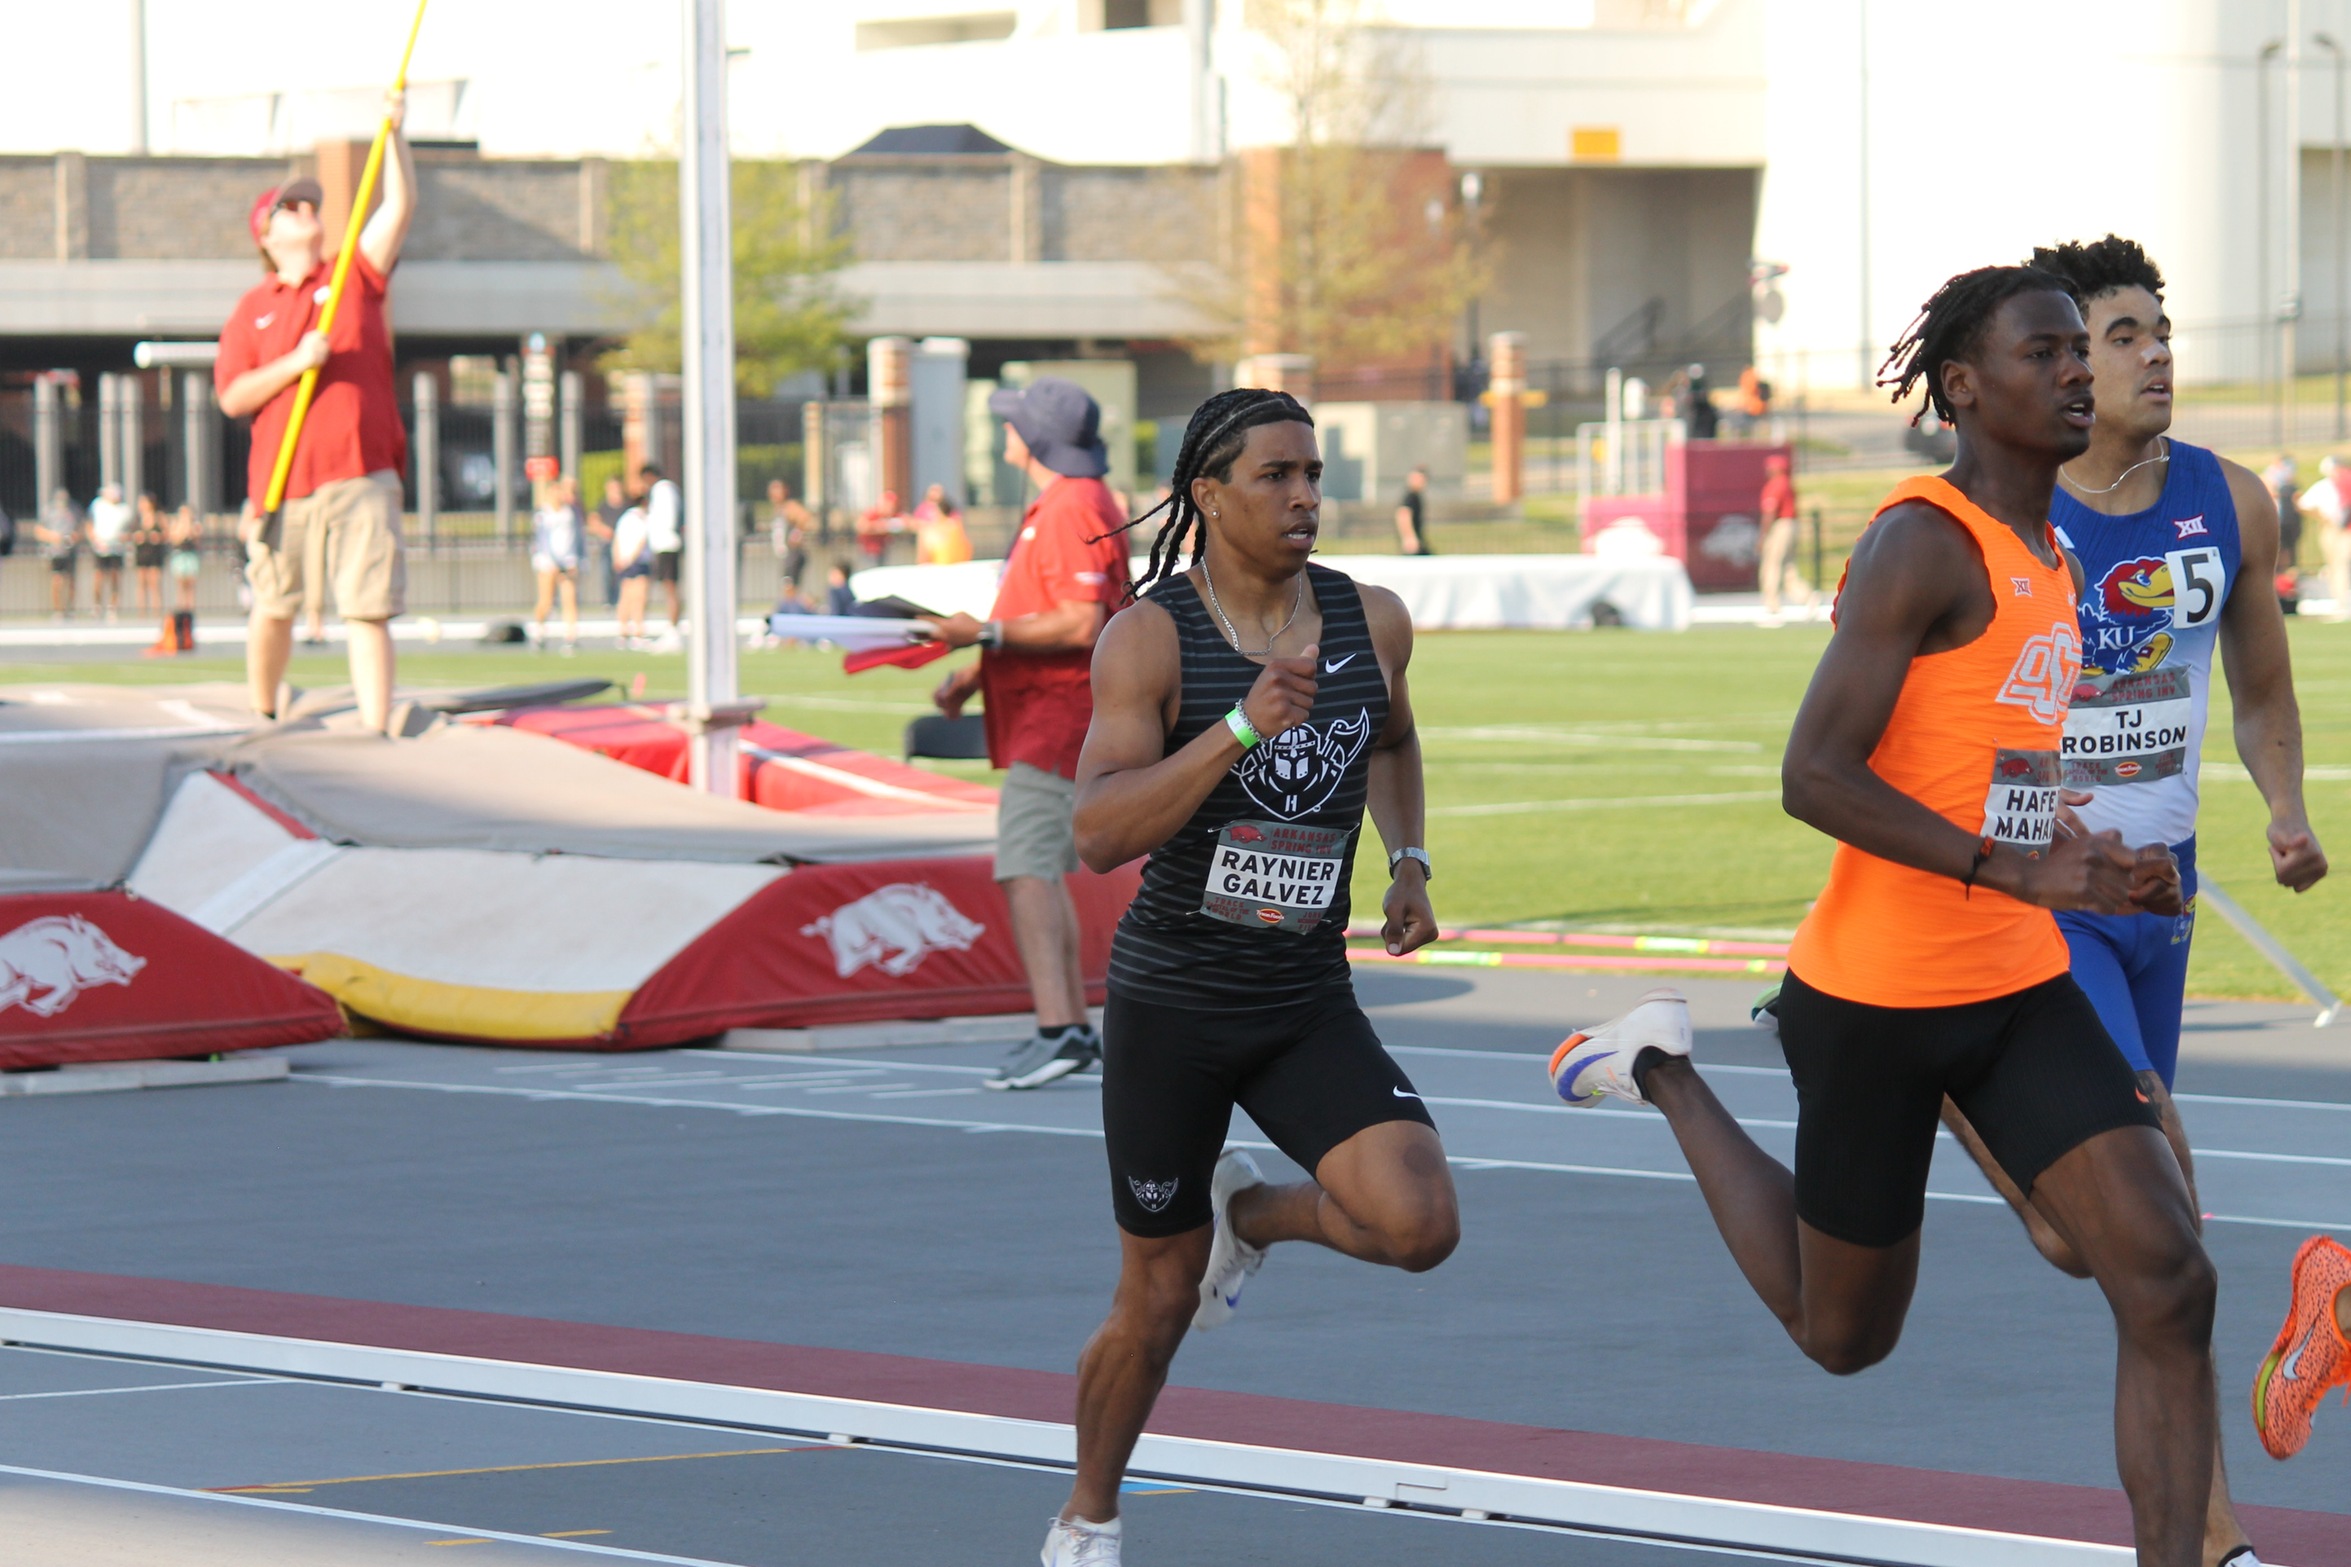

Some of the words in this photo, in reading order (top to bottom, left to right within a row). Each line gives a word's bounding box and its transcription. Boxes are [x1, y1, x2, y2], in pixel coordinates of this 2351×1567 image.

[2181, 553, 2214, 623] 5
[2097, 626, 2136, 650] KU
[2111, 672, 2176, 690] ARKANSAS
[2111, 690, 2153, 702] SPRING
[2157, 686, 2176, 697] INV
[2115, 709, 2142, 729] TJ
[2062, 725, 2187, 754] ROBINSON
[2006, 789, 2060, 813] HAFE
[1271, 840, 1312, 854] SPRING
[1273, 827, 1337, 844] ARKANSAS
[1221, 850, 1335, 881] RAYNIER
[1223, 873, 1324, 905] GALVEZ
